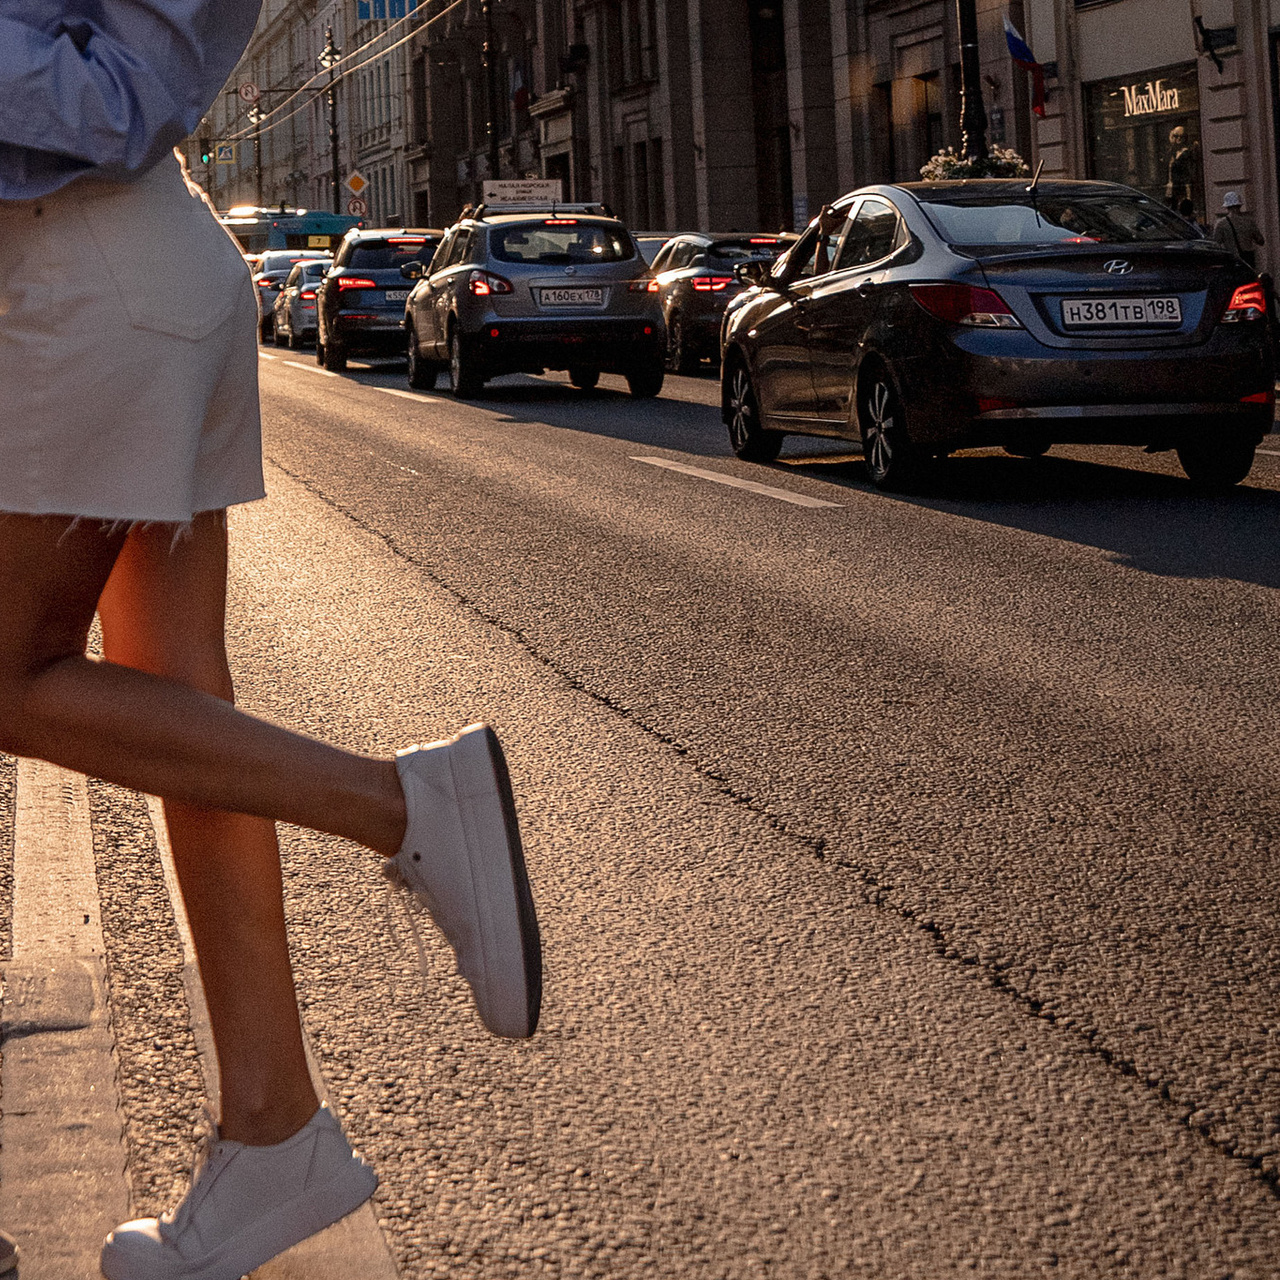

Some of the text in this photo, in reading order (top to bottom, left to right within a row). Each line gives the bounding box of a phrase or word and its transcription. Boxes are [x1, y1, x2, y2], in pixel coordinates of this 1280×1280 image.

[1119, 79, 1179, 117] MaxMara
[1070, 300, 1176, 321] Н381ТВ 198
